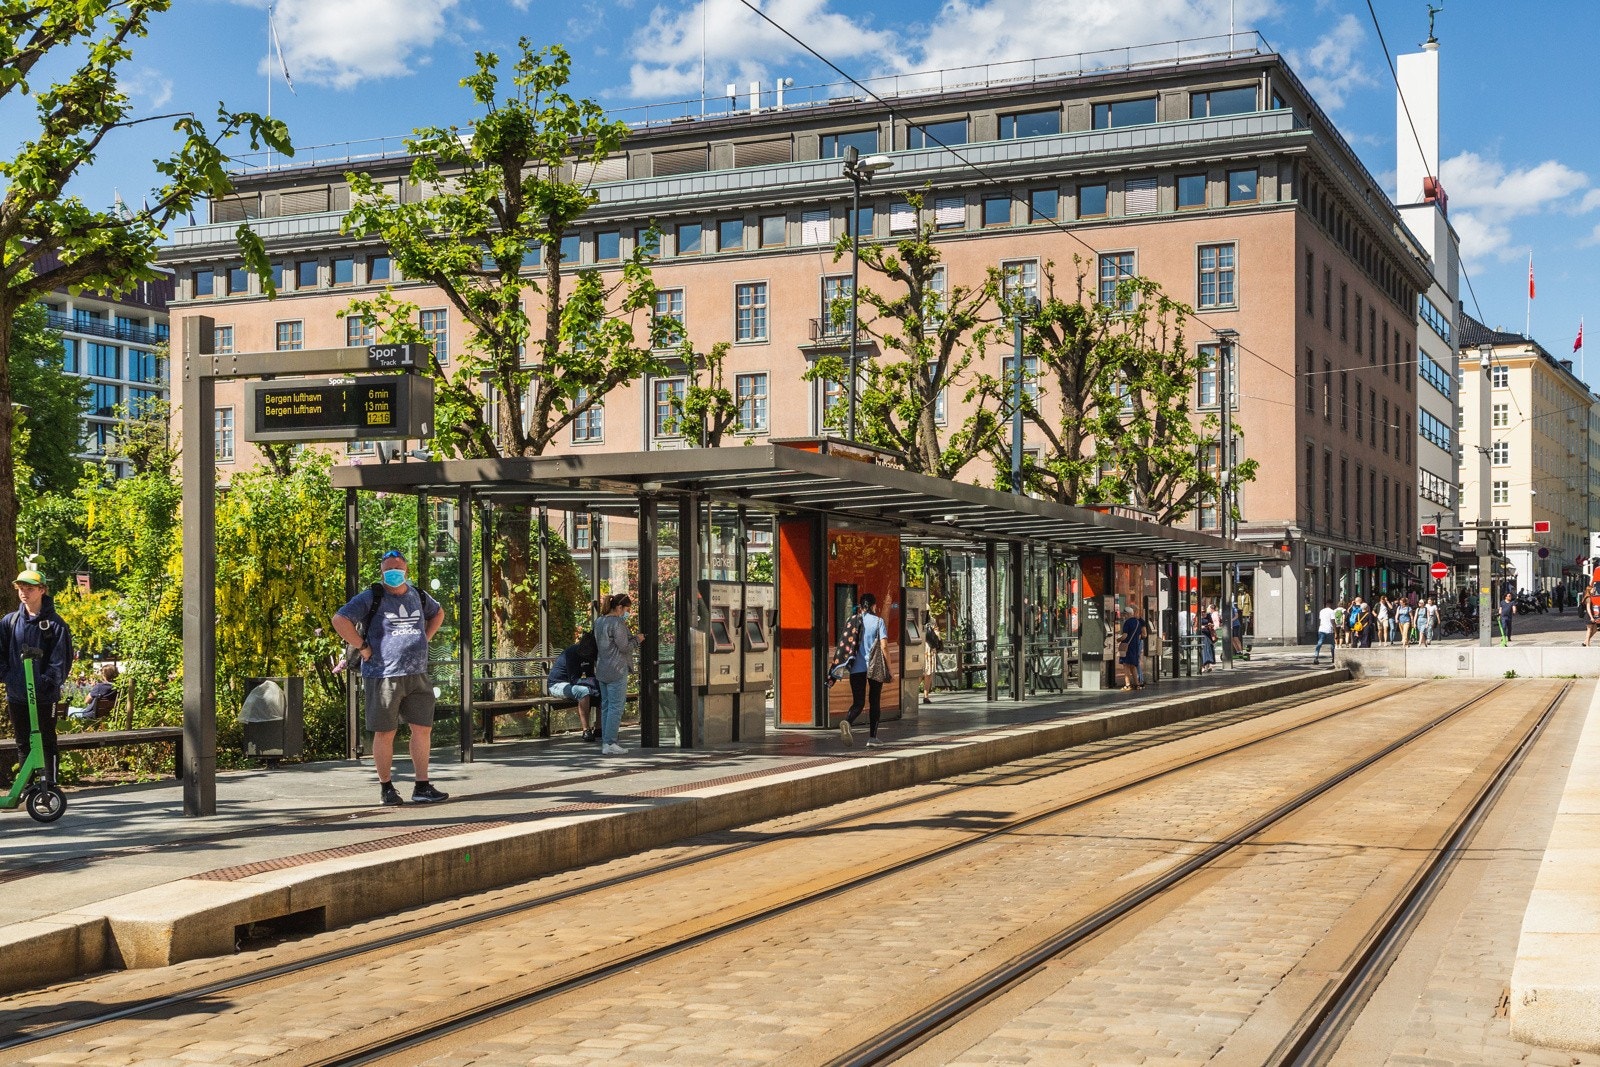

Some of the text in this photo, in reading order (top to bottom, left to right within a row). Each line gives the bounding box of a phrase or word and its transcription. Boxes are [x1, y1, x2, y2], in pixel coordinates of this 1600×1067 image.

[369, 344, 414, 365] Spor 1
[328, 377, 345, 386] Spor
[265, 388, 389, 404] Bergen lufthavn 1 6 min
[265, 400, 389, 416] Bergen lufthavn 1 13 min
